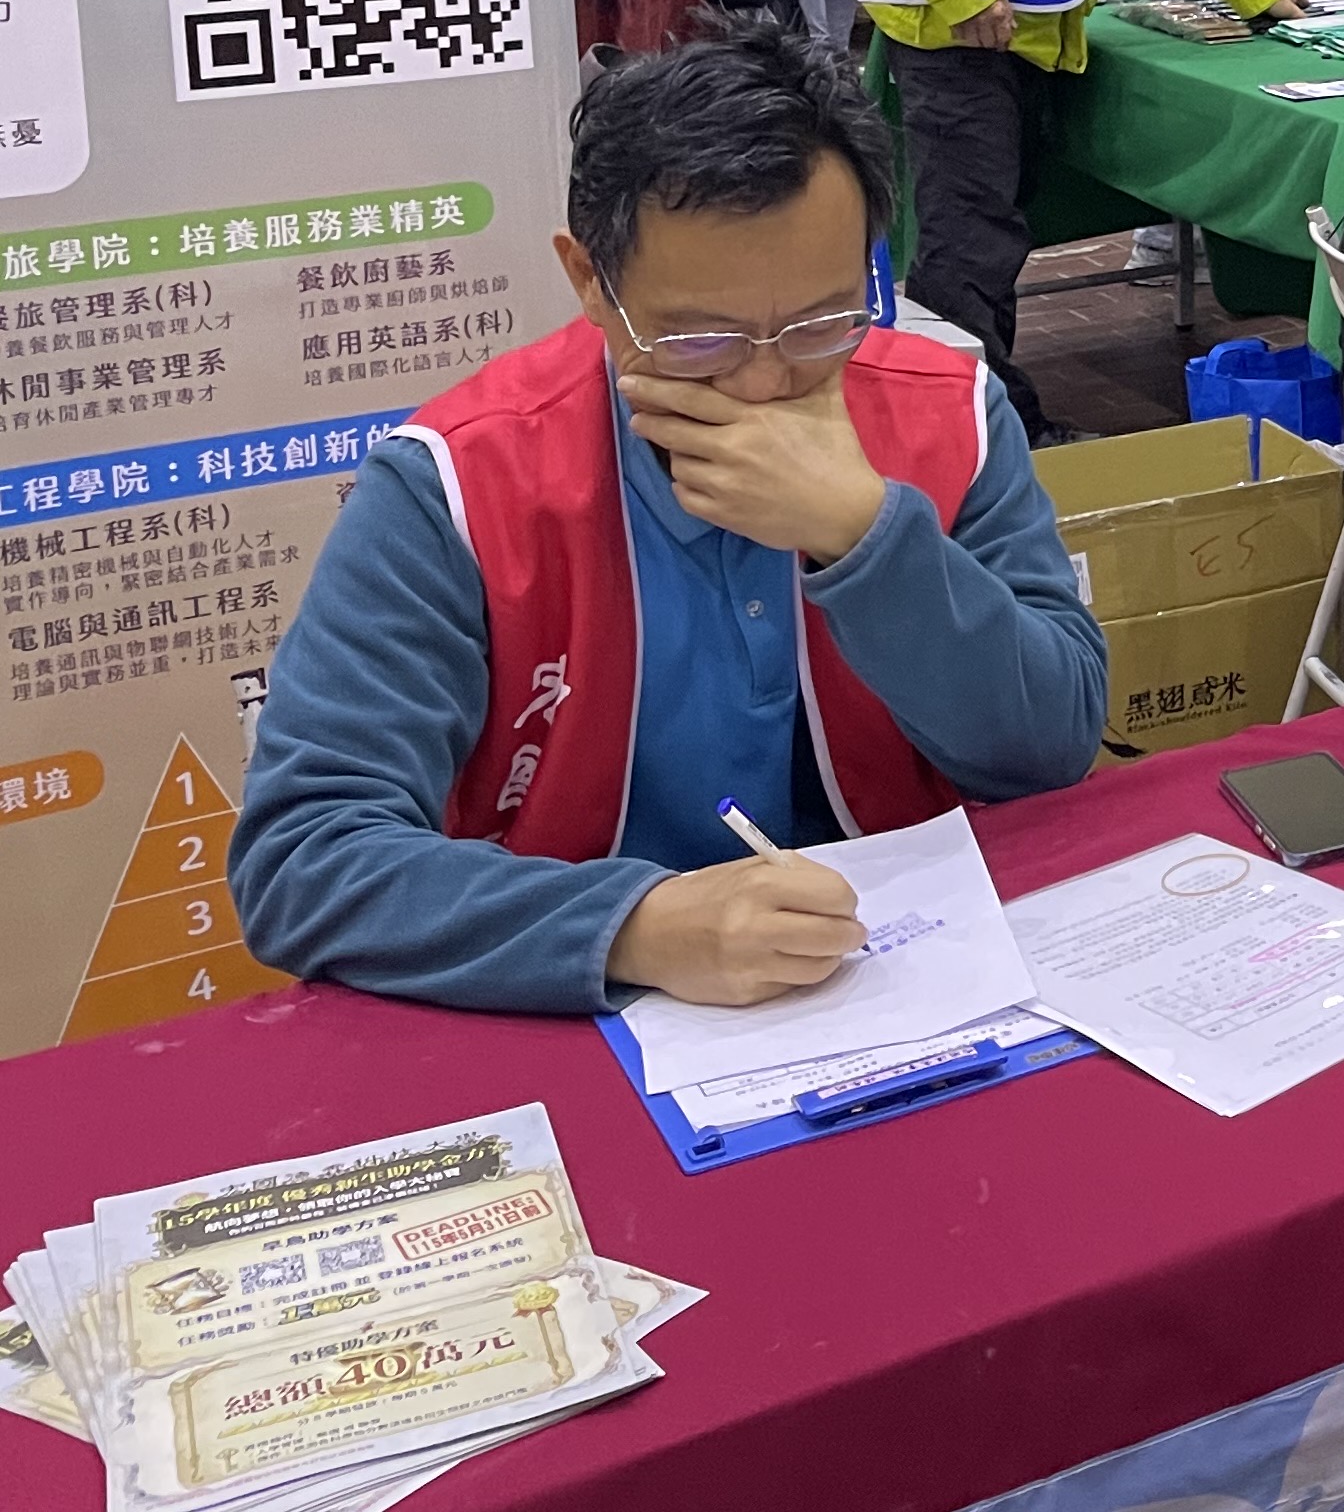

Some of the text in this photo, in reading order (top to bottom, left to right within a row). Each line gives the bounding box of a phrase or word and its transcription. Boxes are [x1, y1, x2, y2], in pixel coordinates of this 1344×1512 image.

[302, 308, 515, 362] 應用英語系(科)
[1, 502, 231, 567] 機械工程系(科)
[8, 580, 280, 652] 電腦與通訊工程系
[175, 772, 194, 805] 1
[177, 836, 206, 872] 2
[186, 900, 213, 936] 3
[187, 968, 216, 1000] 4
[403, 1196, 535, 1242] DEADLINE:
